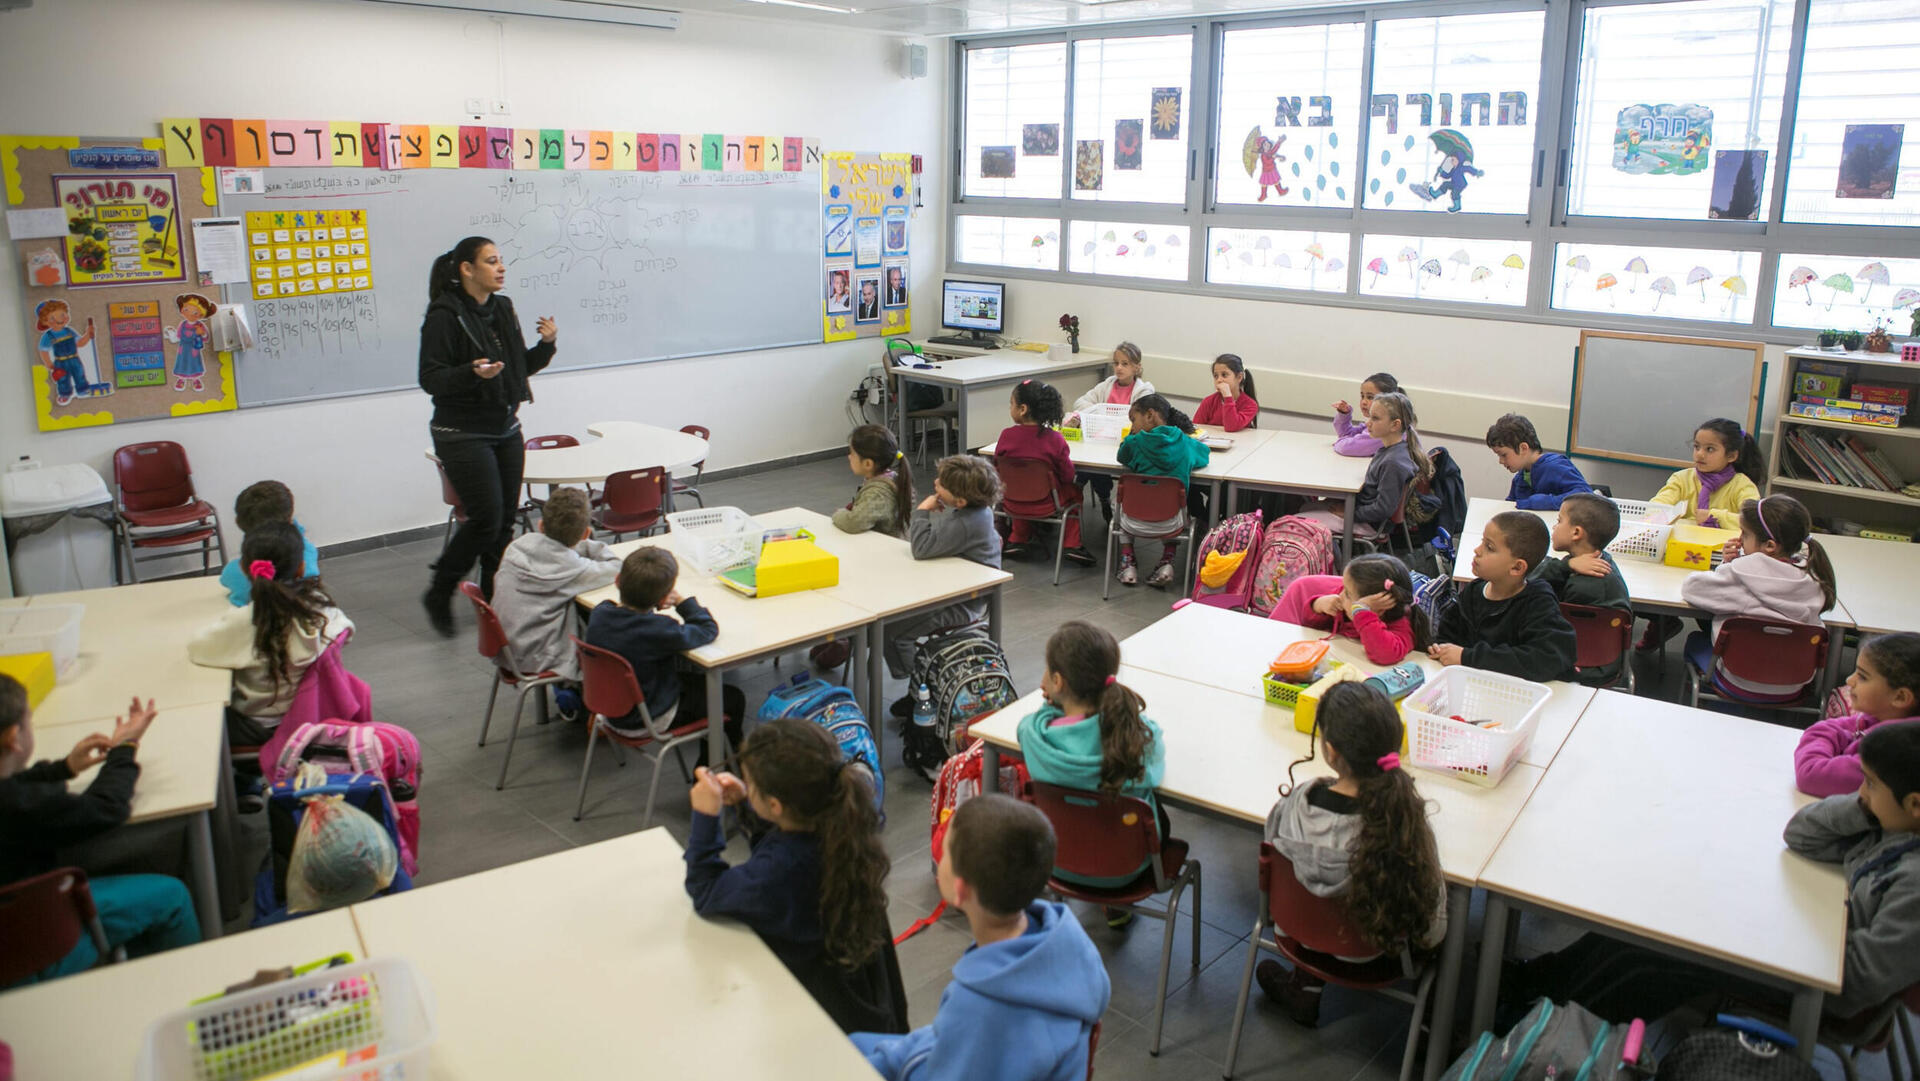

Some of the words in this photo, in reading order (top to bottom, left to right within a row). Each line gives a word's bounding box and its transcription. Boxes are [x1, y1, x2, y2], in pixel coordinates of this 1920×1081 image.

[1274, 96, 1334, 127] בא
[1371, 91, 1528, 135] החורף
[836, 156, 905, 186] ישראל
[65, 181, 136, 210] תורן?
[143, 185, 170, 208] מי
[848, 187, 886, 214] שלי
[102, 208, 130, 219] ראשון
[132, 208, 143, 217] יום
[257, 302, 276, 318] 88
